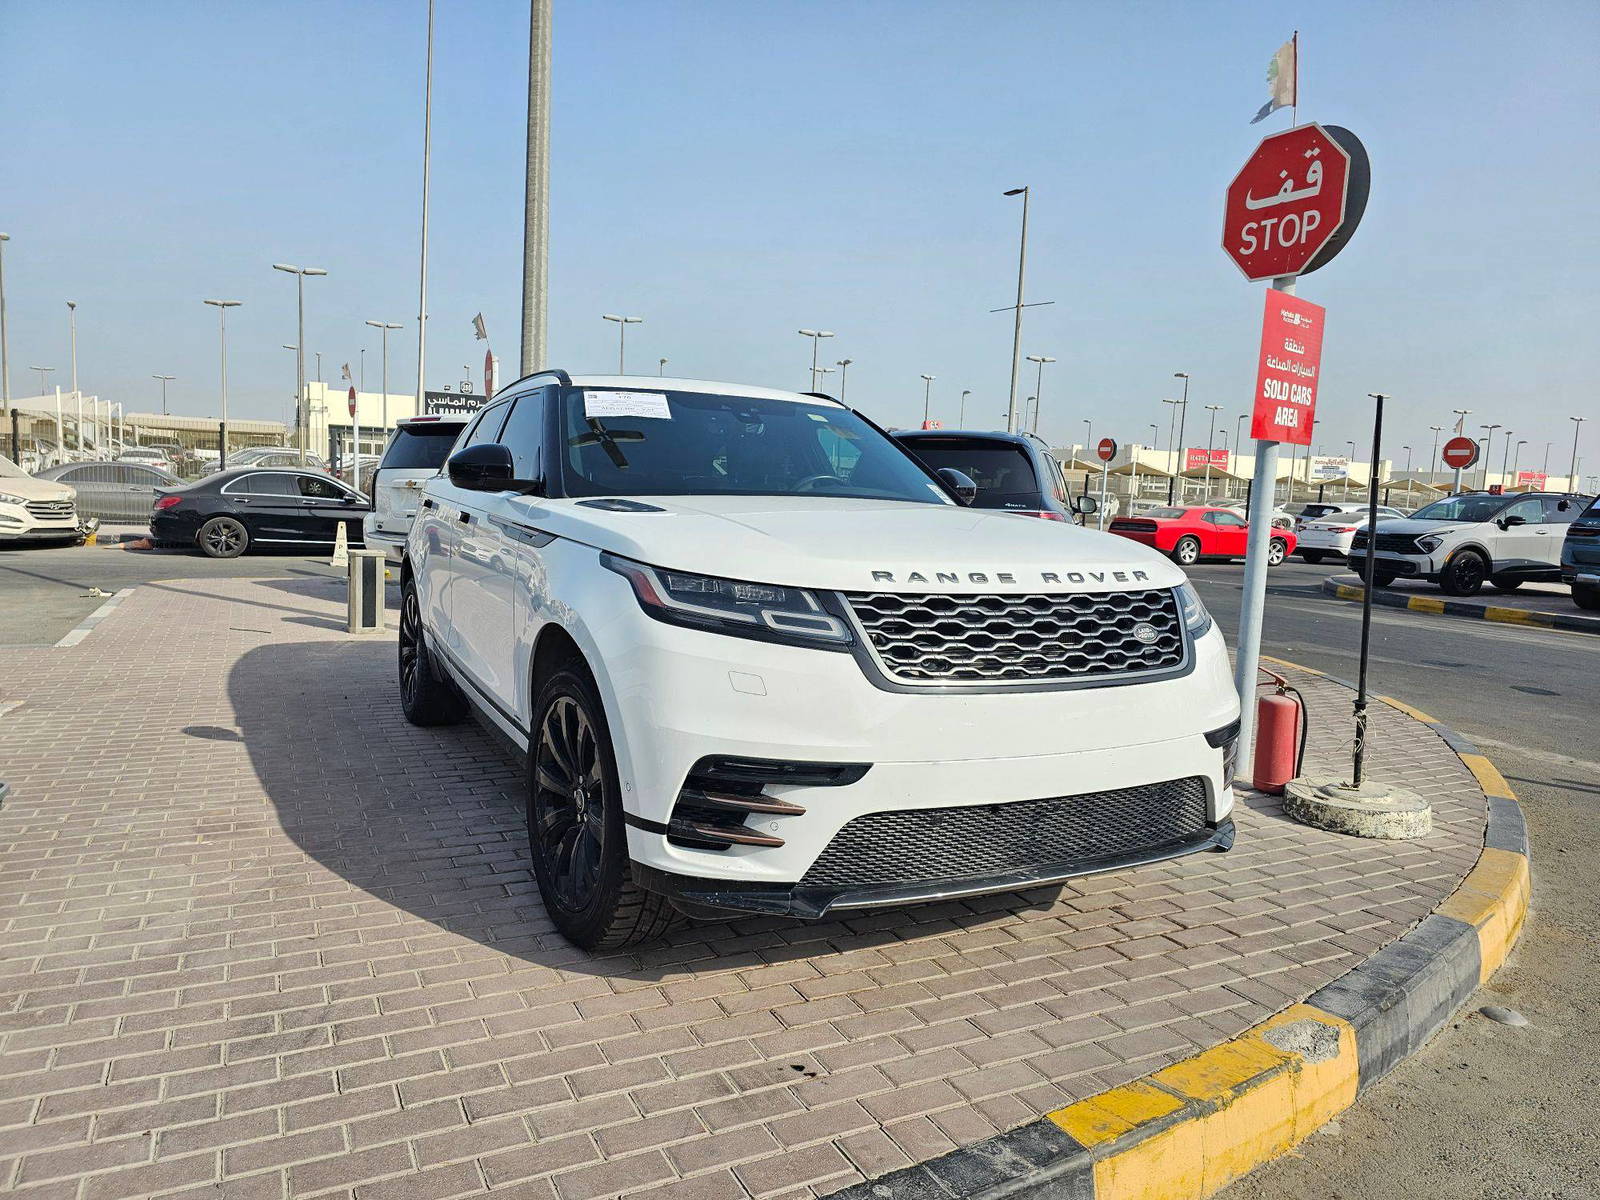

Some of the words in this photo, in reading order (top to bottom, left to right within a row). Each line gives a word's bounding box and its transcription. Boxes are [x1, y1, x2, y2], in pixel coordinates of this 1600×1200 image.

[1245, 147, 1324, 210] قف
[1239, 209, 1321, 255] STOP
[1284, 337, 1305, 355] منطقة
[1291, 361, 1316, 378] السيارات
[1263, 378, 1289, 401] SOLD
[1290, 383, 1312, 406] CARS
[1274, 406, 1298, 428] AREA
[871, 570, 1017, 584] RANGE
[1040, 570, 1151, 584] ROVER
